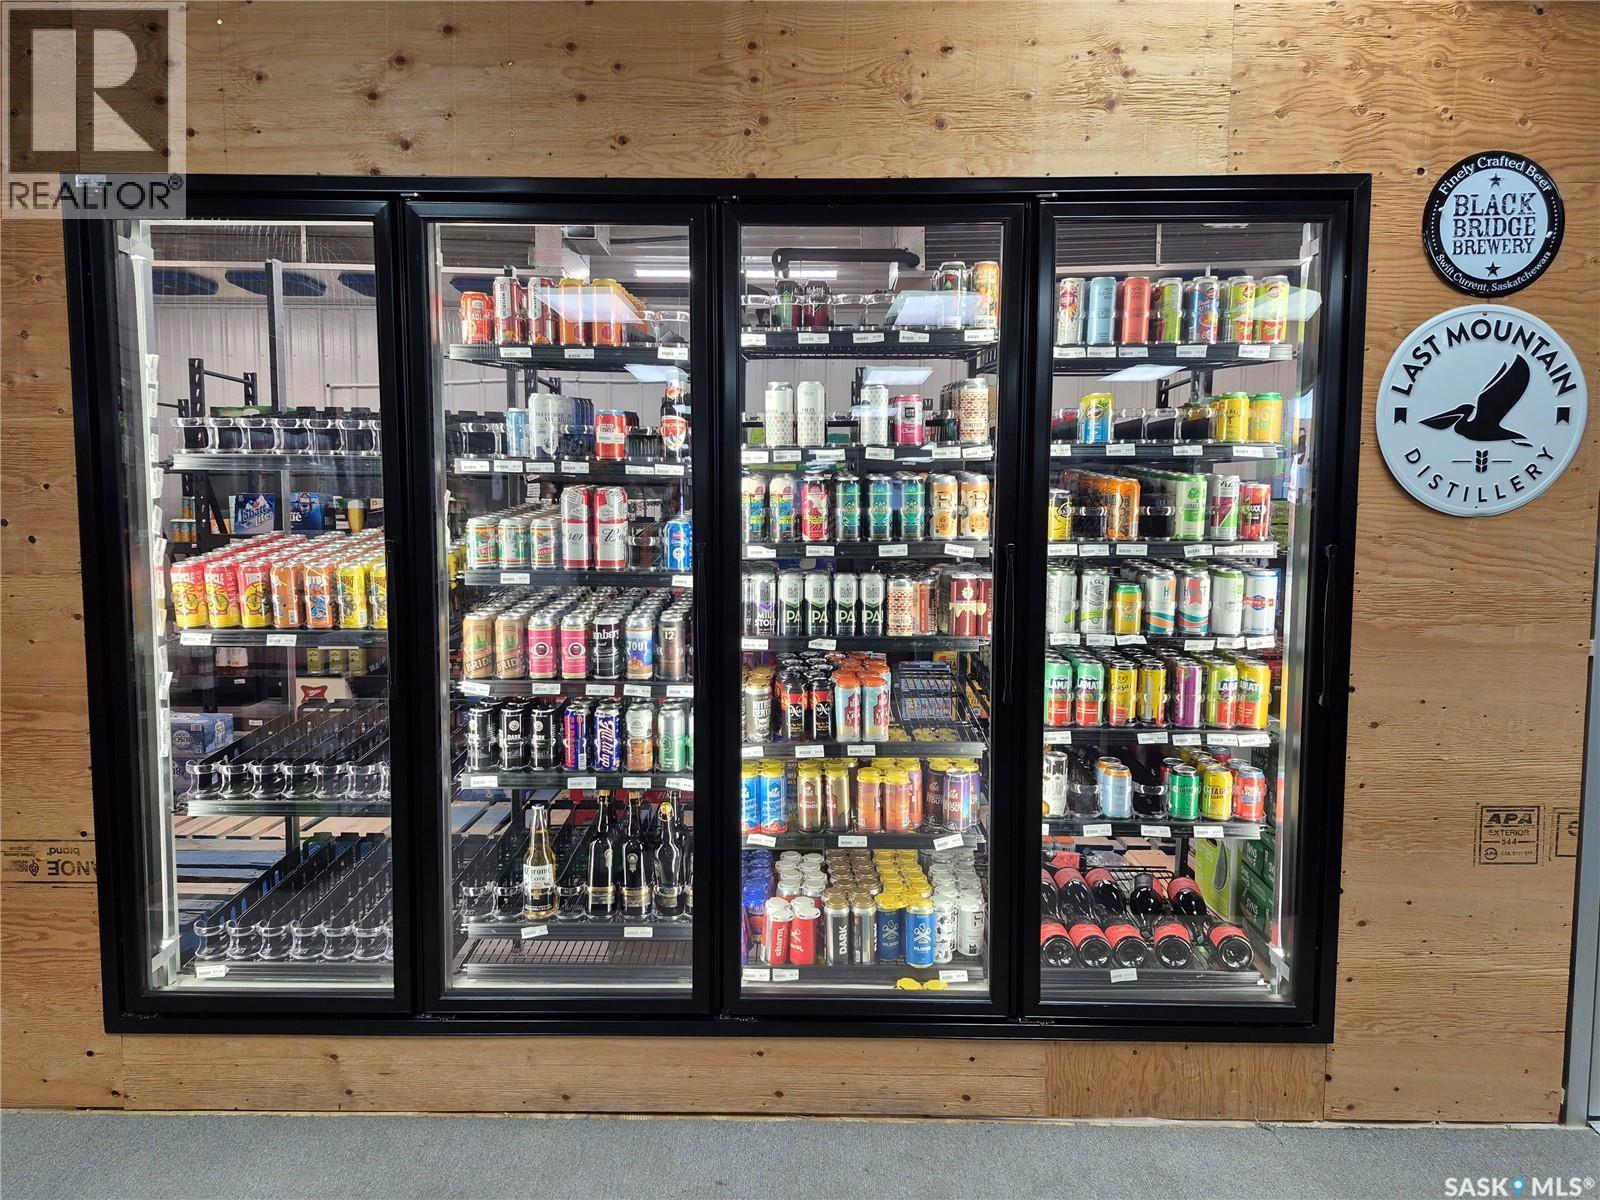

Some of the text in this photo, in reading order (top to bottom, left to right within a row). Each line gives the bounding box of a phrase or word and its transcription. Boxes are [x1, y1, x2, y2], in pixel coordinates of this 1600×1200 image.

[1438, 155, 1552, 195] Finely Crafted Beer
[1453, 193, 1536, 217] BLACK
[1453, 217, 1536, 238] BRIDGE
[1452, 238, 1535, 255] BREWERY
[1436, 251, 1551, 293] Swift Current, Saskatchewan
[1391, 318, 1577, 396] LAST MOUNTAIN
[1404, 446, 1554, 503] DISTILLERY
[1486, 813, 1533, 824] APA
[49, 847, 80, 856] brand
[838, 925, 848, 955] DARK
